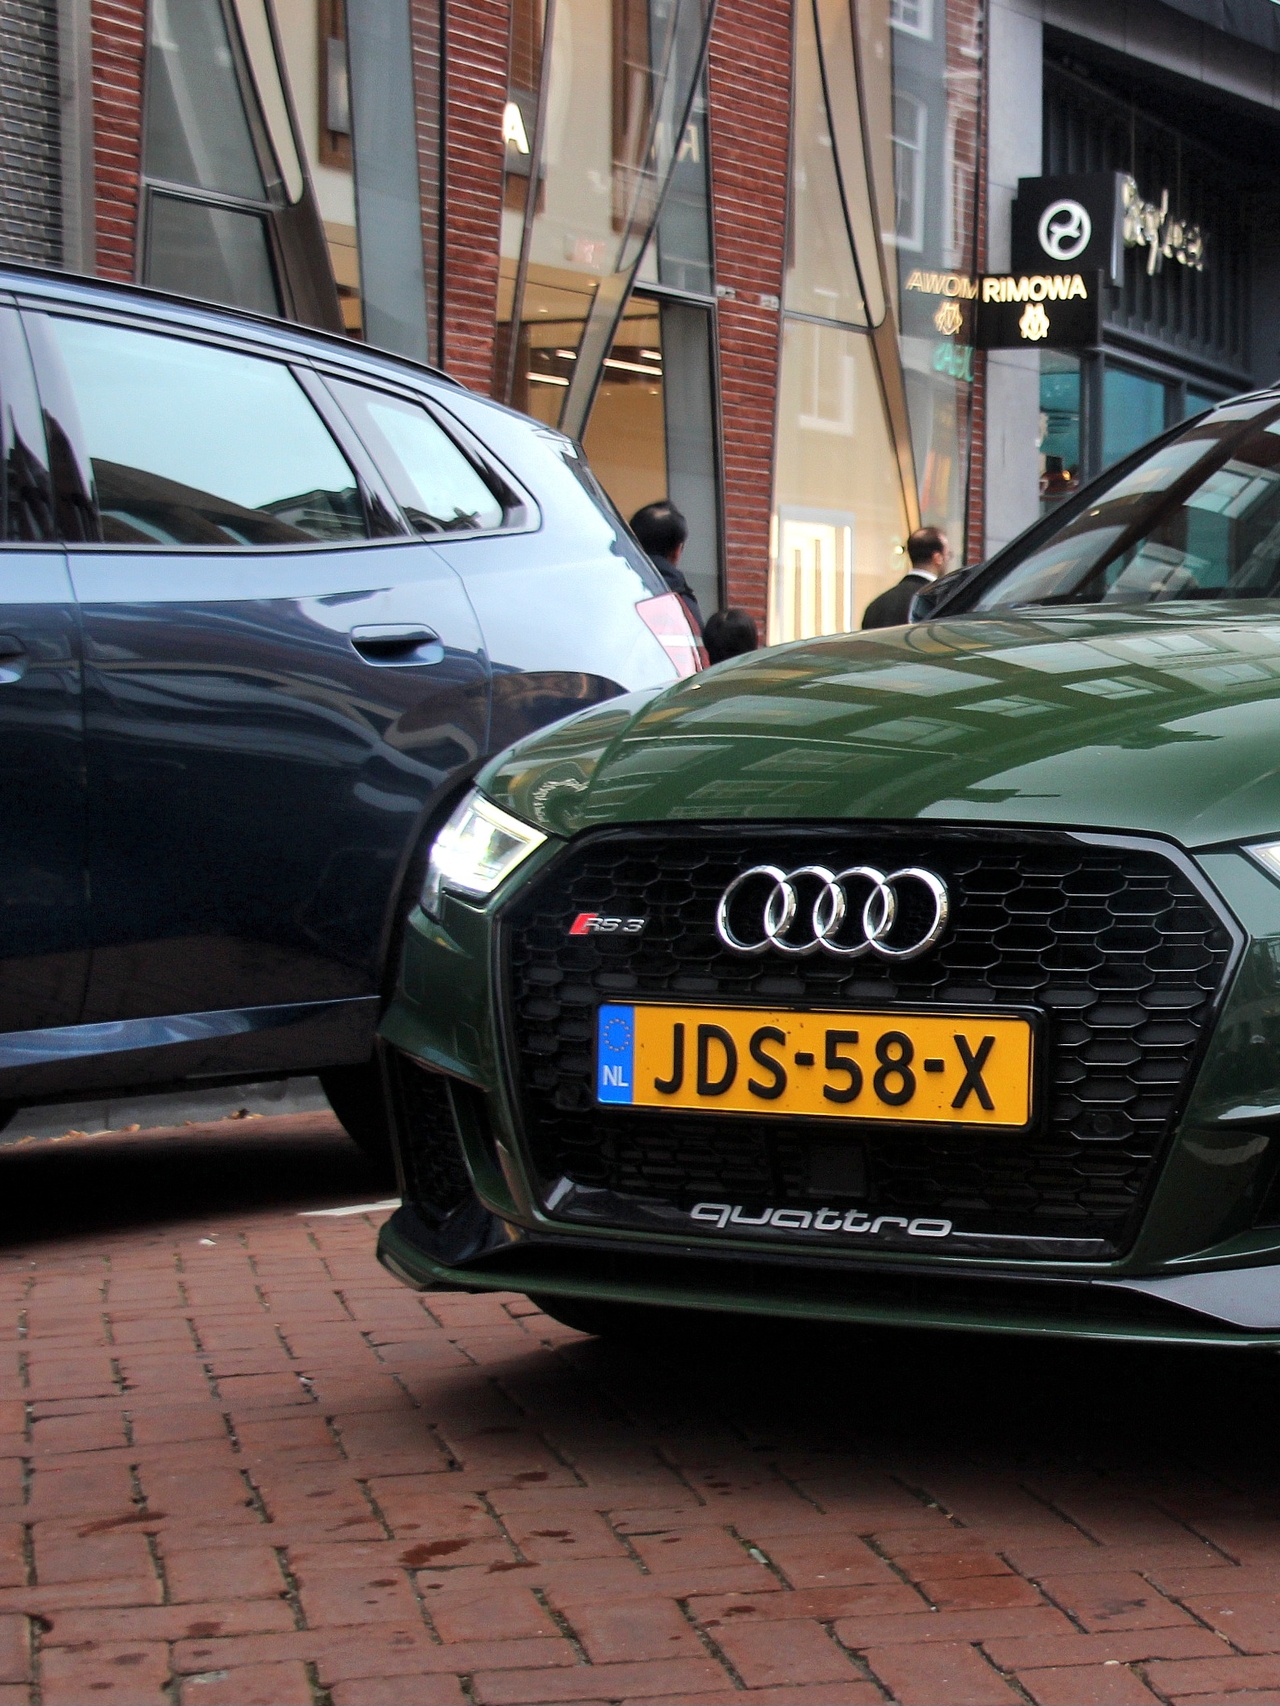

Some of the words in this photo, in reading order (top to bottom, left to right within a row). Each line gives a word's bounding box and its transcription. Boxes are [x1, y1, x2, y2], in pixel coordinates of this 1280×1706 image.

[982, 273, 1088, 303] RIMOWA
[602, 1063, 629, 1088] NL
[654, 1021, 997, 1111] JDS-58-X
[690, 1202, 953, 1238] quattro
